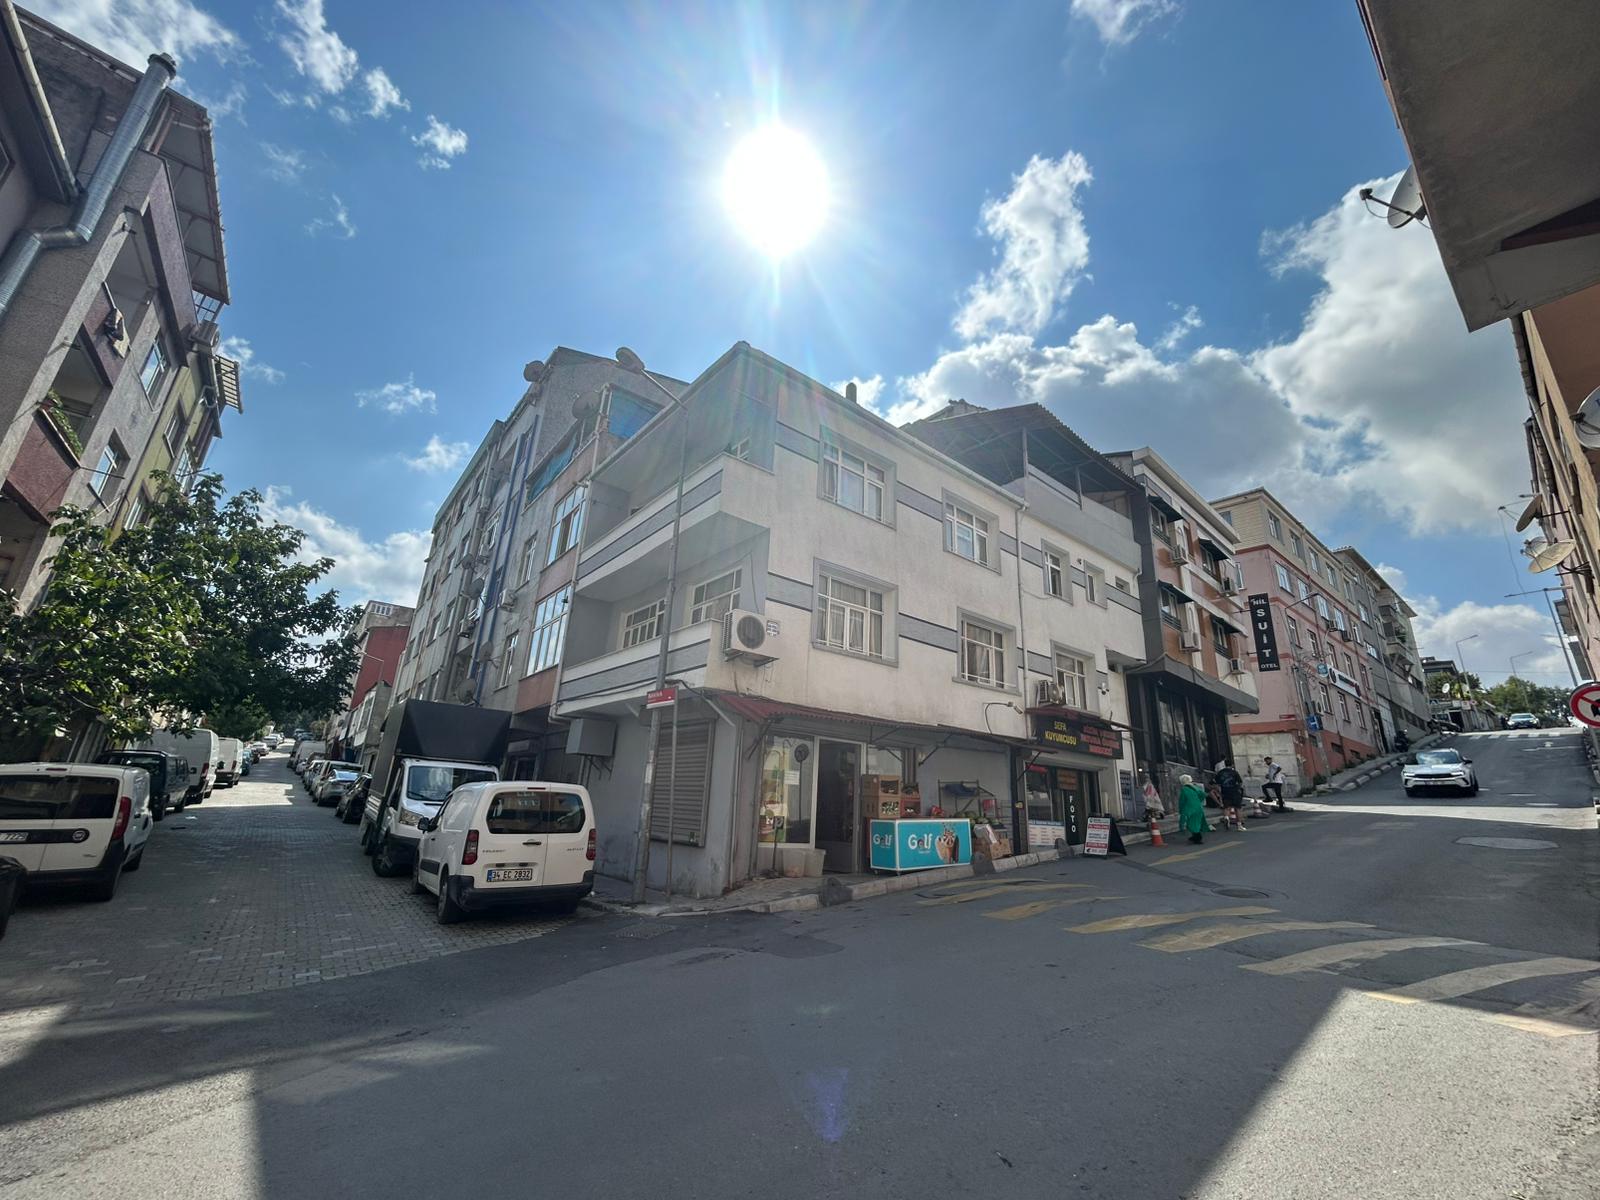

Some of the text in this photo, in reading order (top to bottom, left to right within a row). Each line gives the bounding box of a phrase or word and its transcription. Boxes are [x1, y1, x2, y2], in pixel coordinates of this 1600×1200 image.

[1044, 730, 1077, 746] KUYUMCUSU
[1069, 795, 1077, 833] FOTO
[872, 833, 893, 846] Golf
[907, 833, 934, 850] Golf
[492, 870, 531, 880] 34 EC 2832
